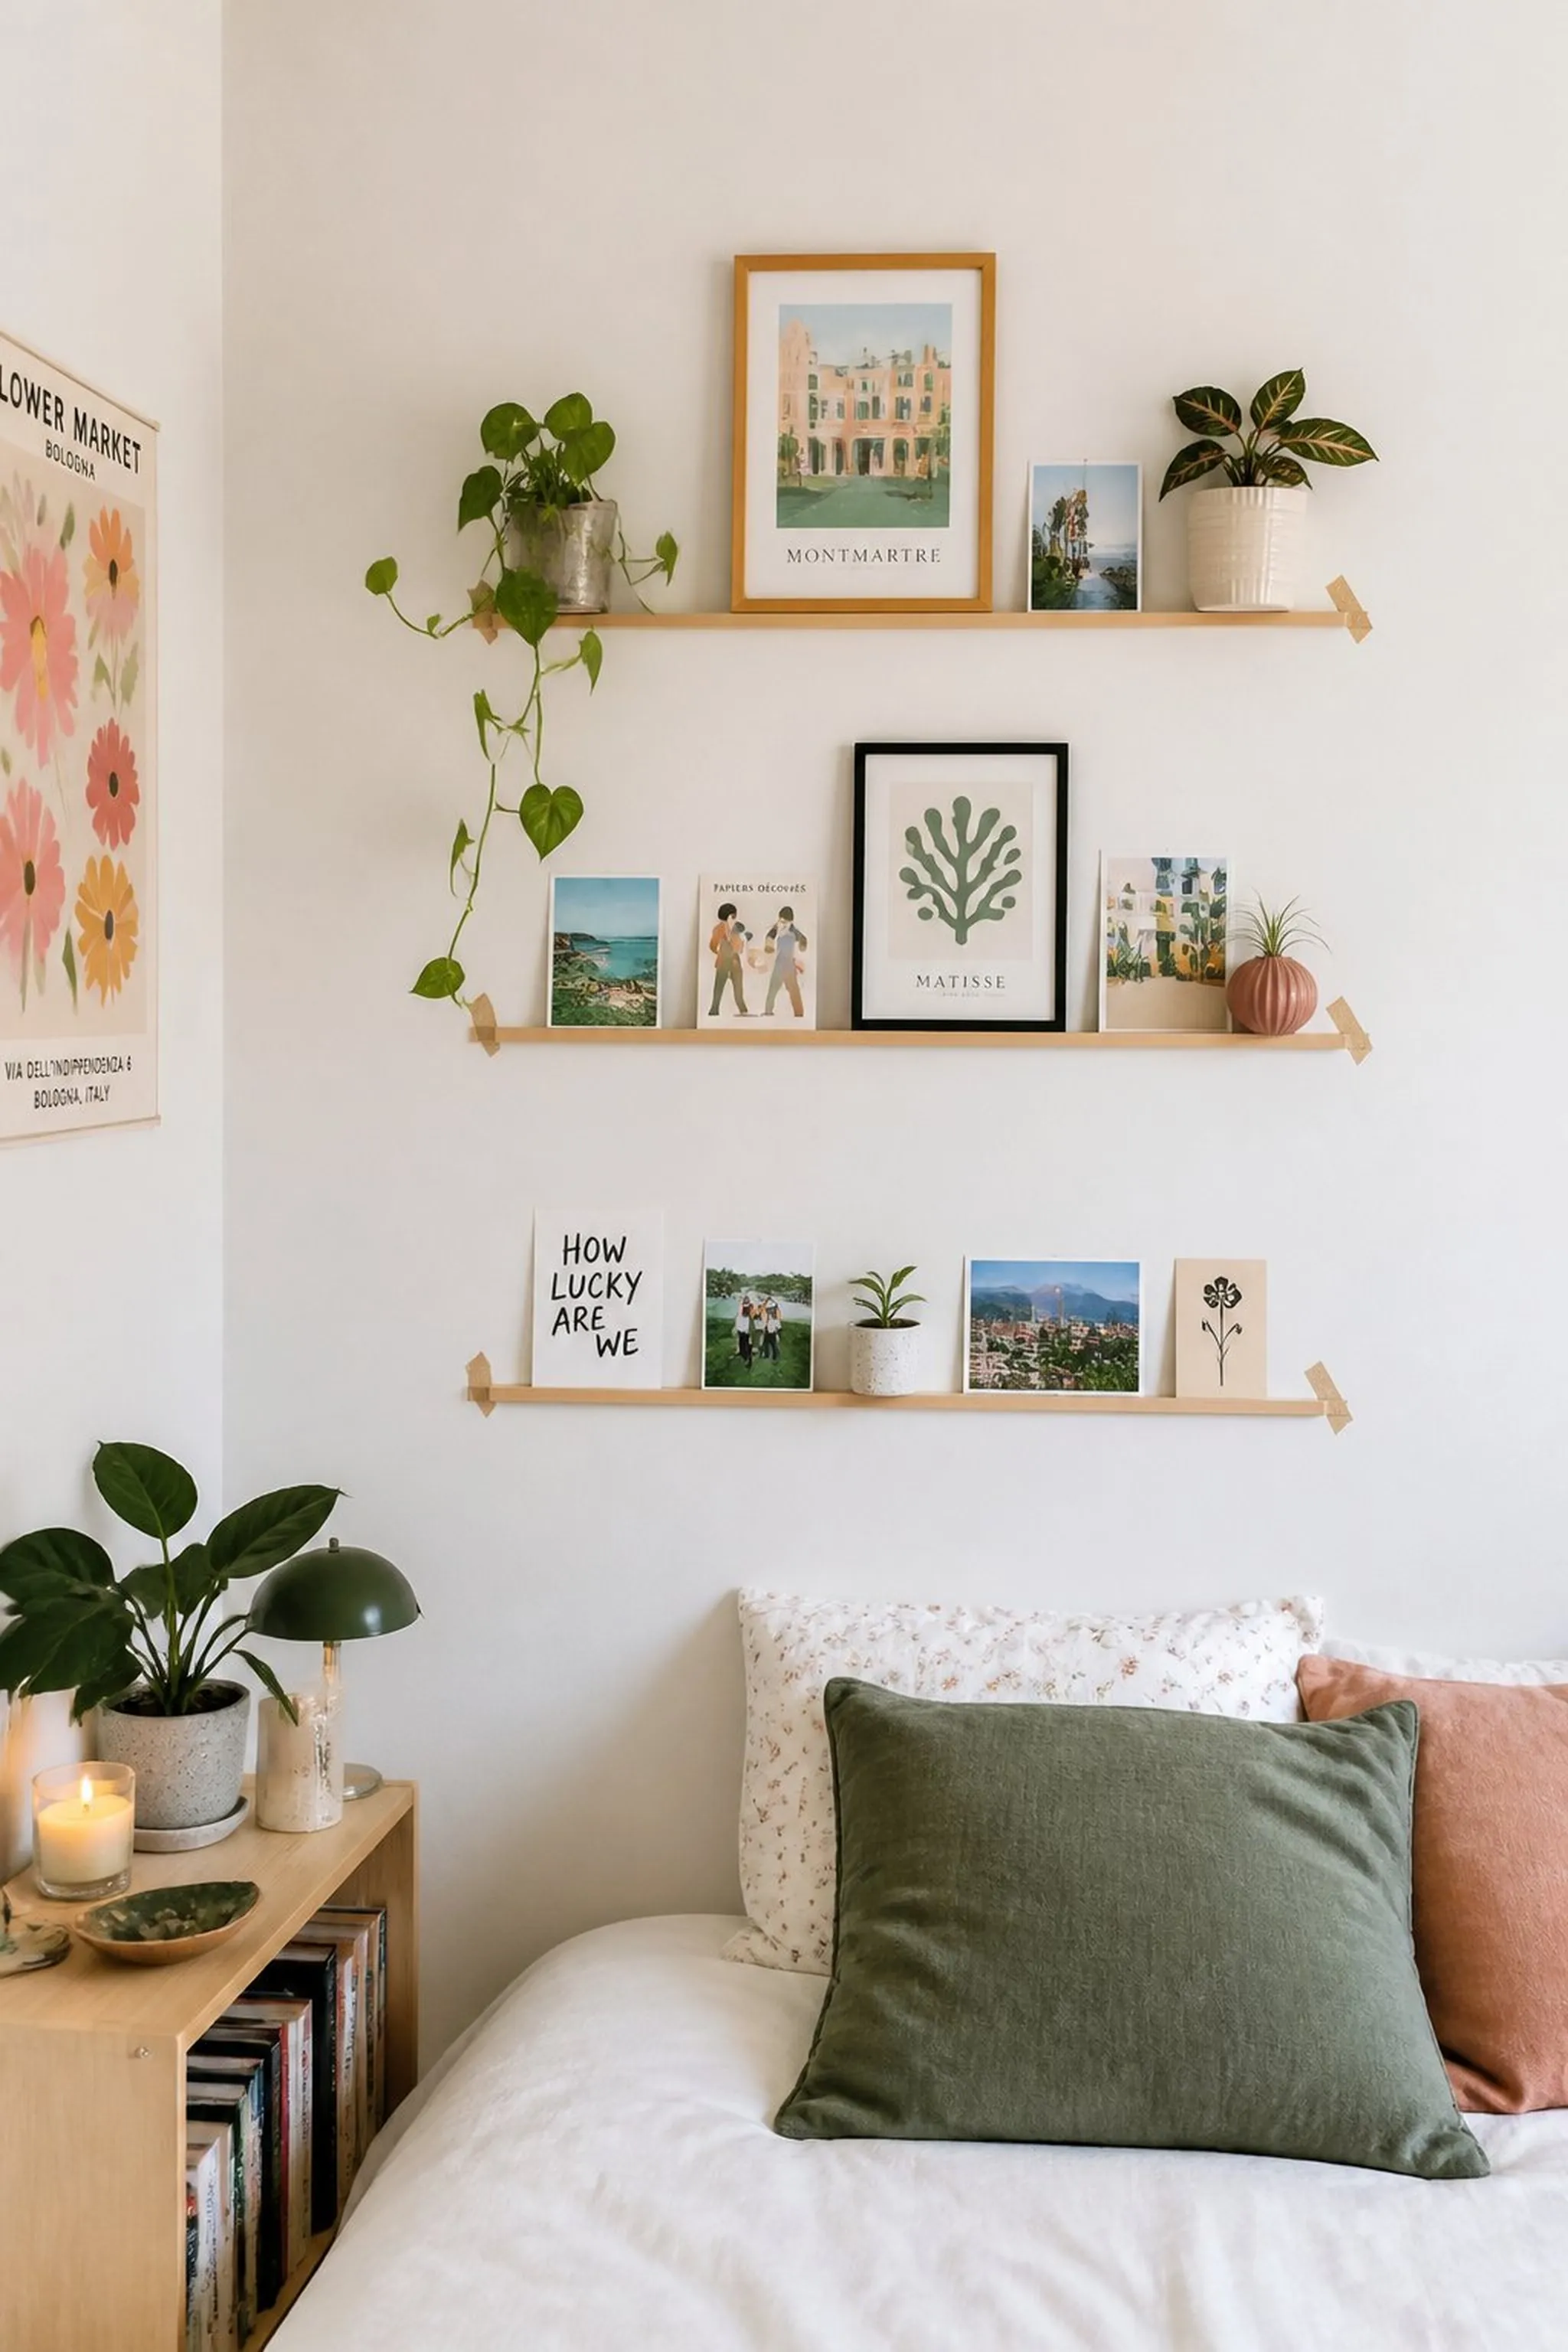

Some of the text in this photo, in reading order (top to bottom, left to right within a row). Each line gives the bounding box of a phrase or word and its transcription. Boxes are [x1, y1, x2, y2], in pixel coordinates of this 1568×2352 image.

[74, 406, 141, 474] MARKET
[45, 439, 96, 481] BOLOGNA
[786, 548, 941, 563] MONTMARTRE
[916, 975, 1006, 989] MATISSE
[5, 1061, 23, 1080] VIA
[34, 1085, 110, 1109] BOLOGNA, ITALY
[563, 1233, 626, 1266] HOW
[551, 1271, 642, 1305] LUCKY
[552, 1305, 605, 1336] ARE
[596, 1328, 639, 1358] WE
